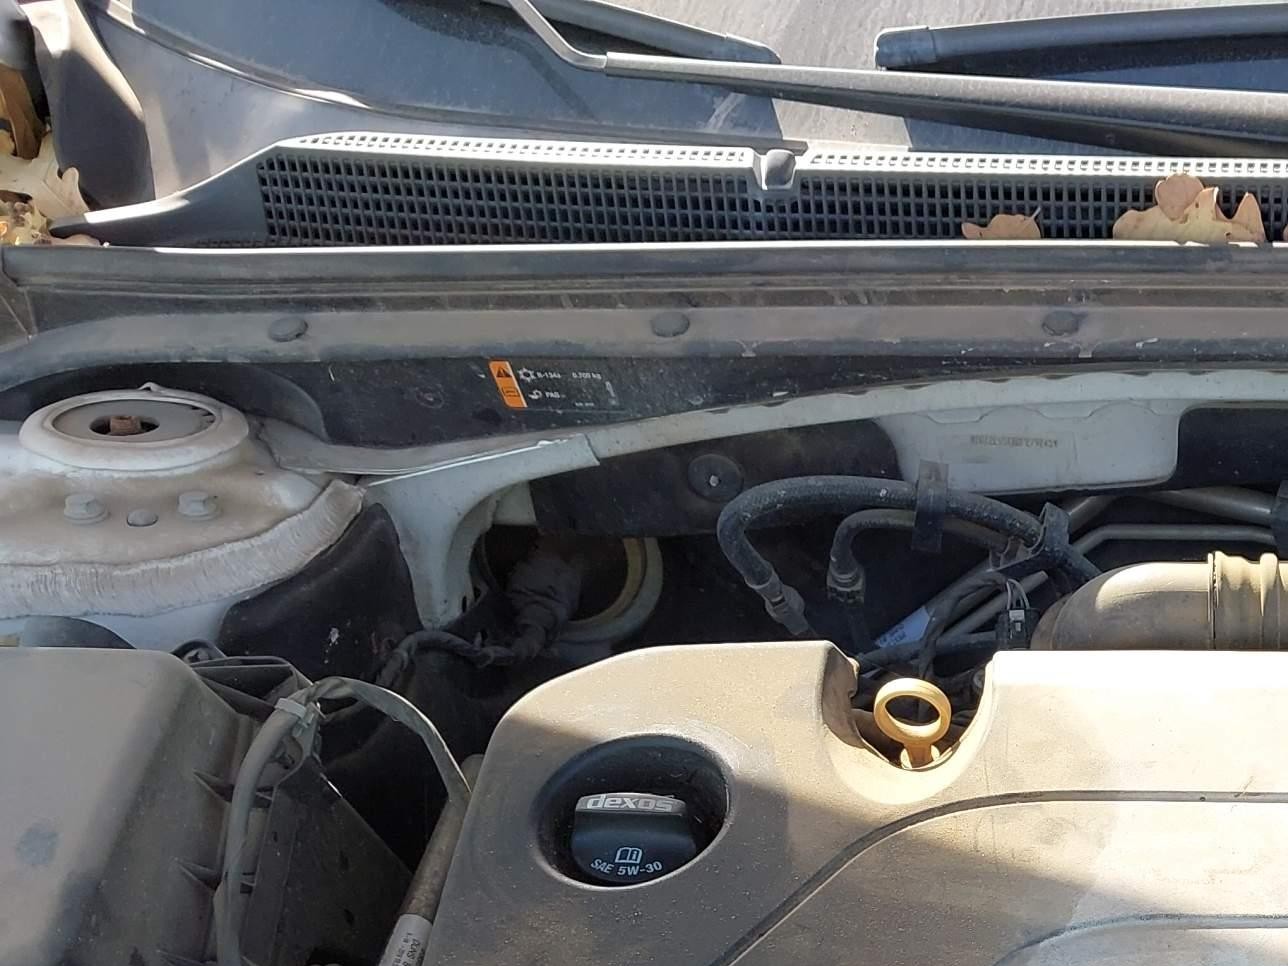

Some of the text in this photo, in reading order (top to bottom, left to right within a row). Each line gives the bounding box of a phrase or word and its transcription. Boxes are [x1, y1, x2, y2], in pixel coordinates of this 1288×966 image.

[586, 794, 674, 812] dexos
[590, 858, 663, 876] SAE 5W-30
